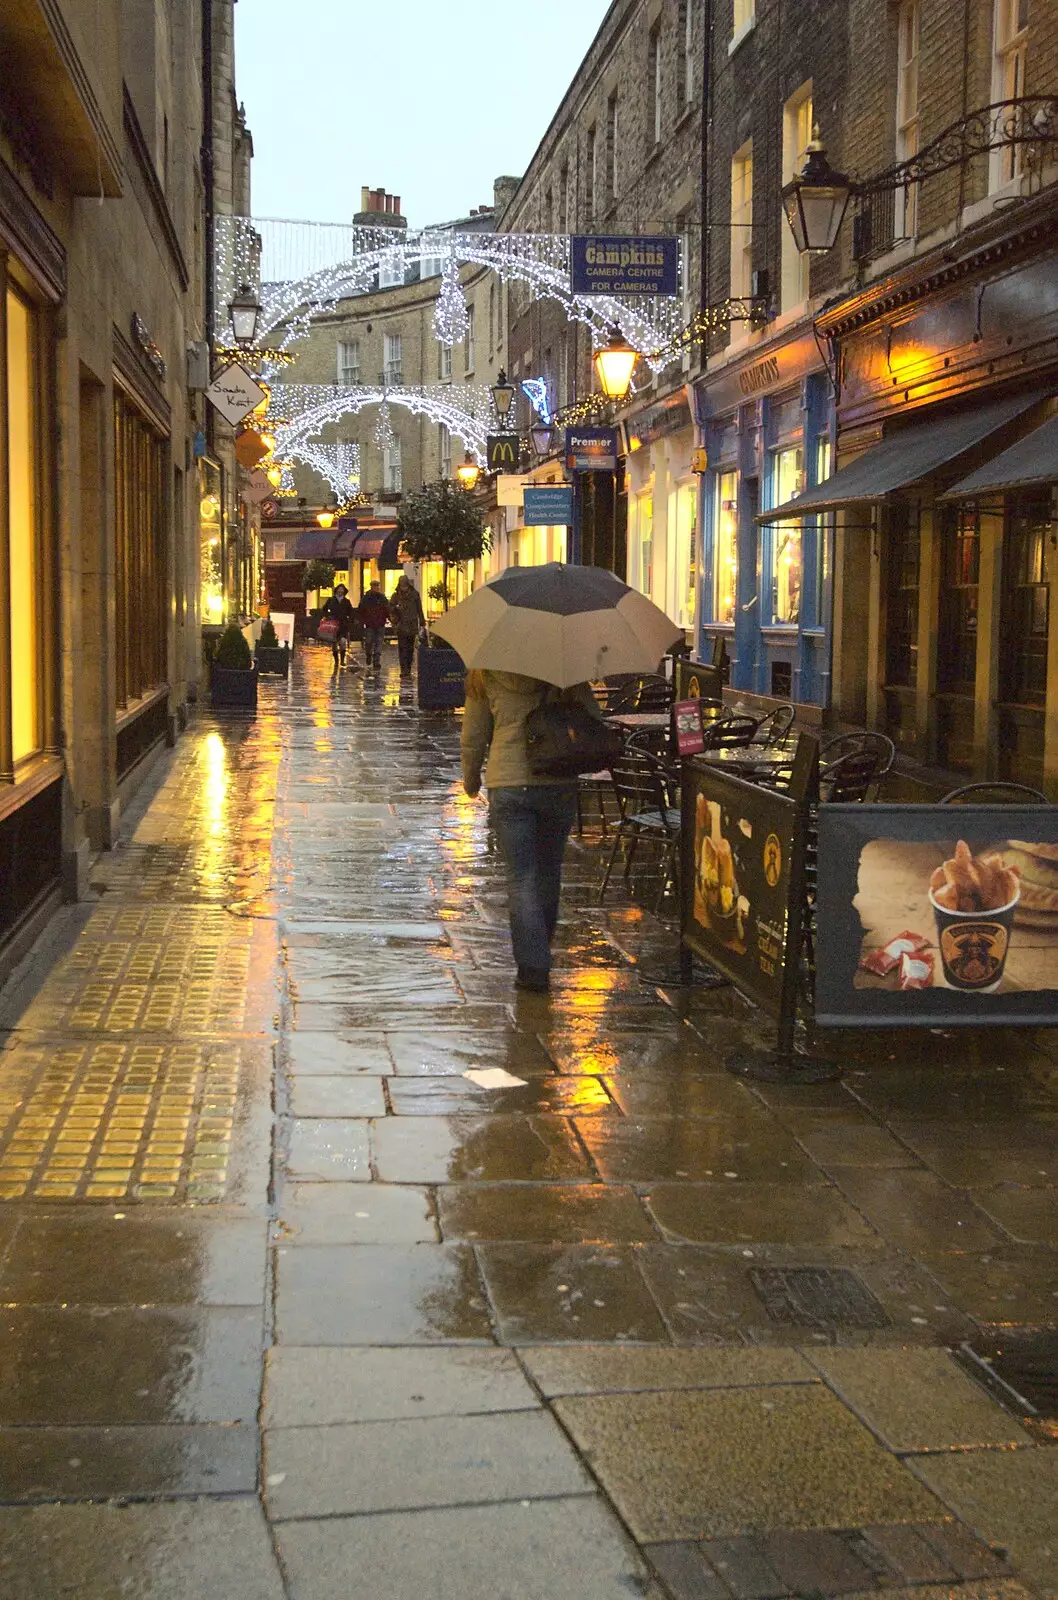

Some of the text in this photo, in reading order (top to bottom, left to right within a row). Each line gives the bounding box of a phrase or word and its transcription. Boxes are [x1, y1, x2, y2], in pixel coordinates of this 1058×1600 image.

[585, 247, 664, 267] Campkins
[586, 267, 664, 277] CAMERA CENTRE
[591, 282, 658, 291] FOR CAMERAS
